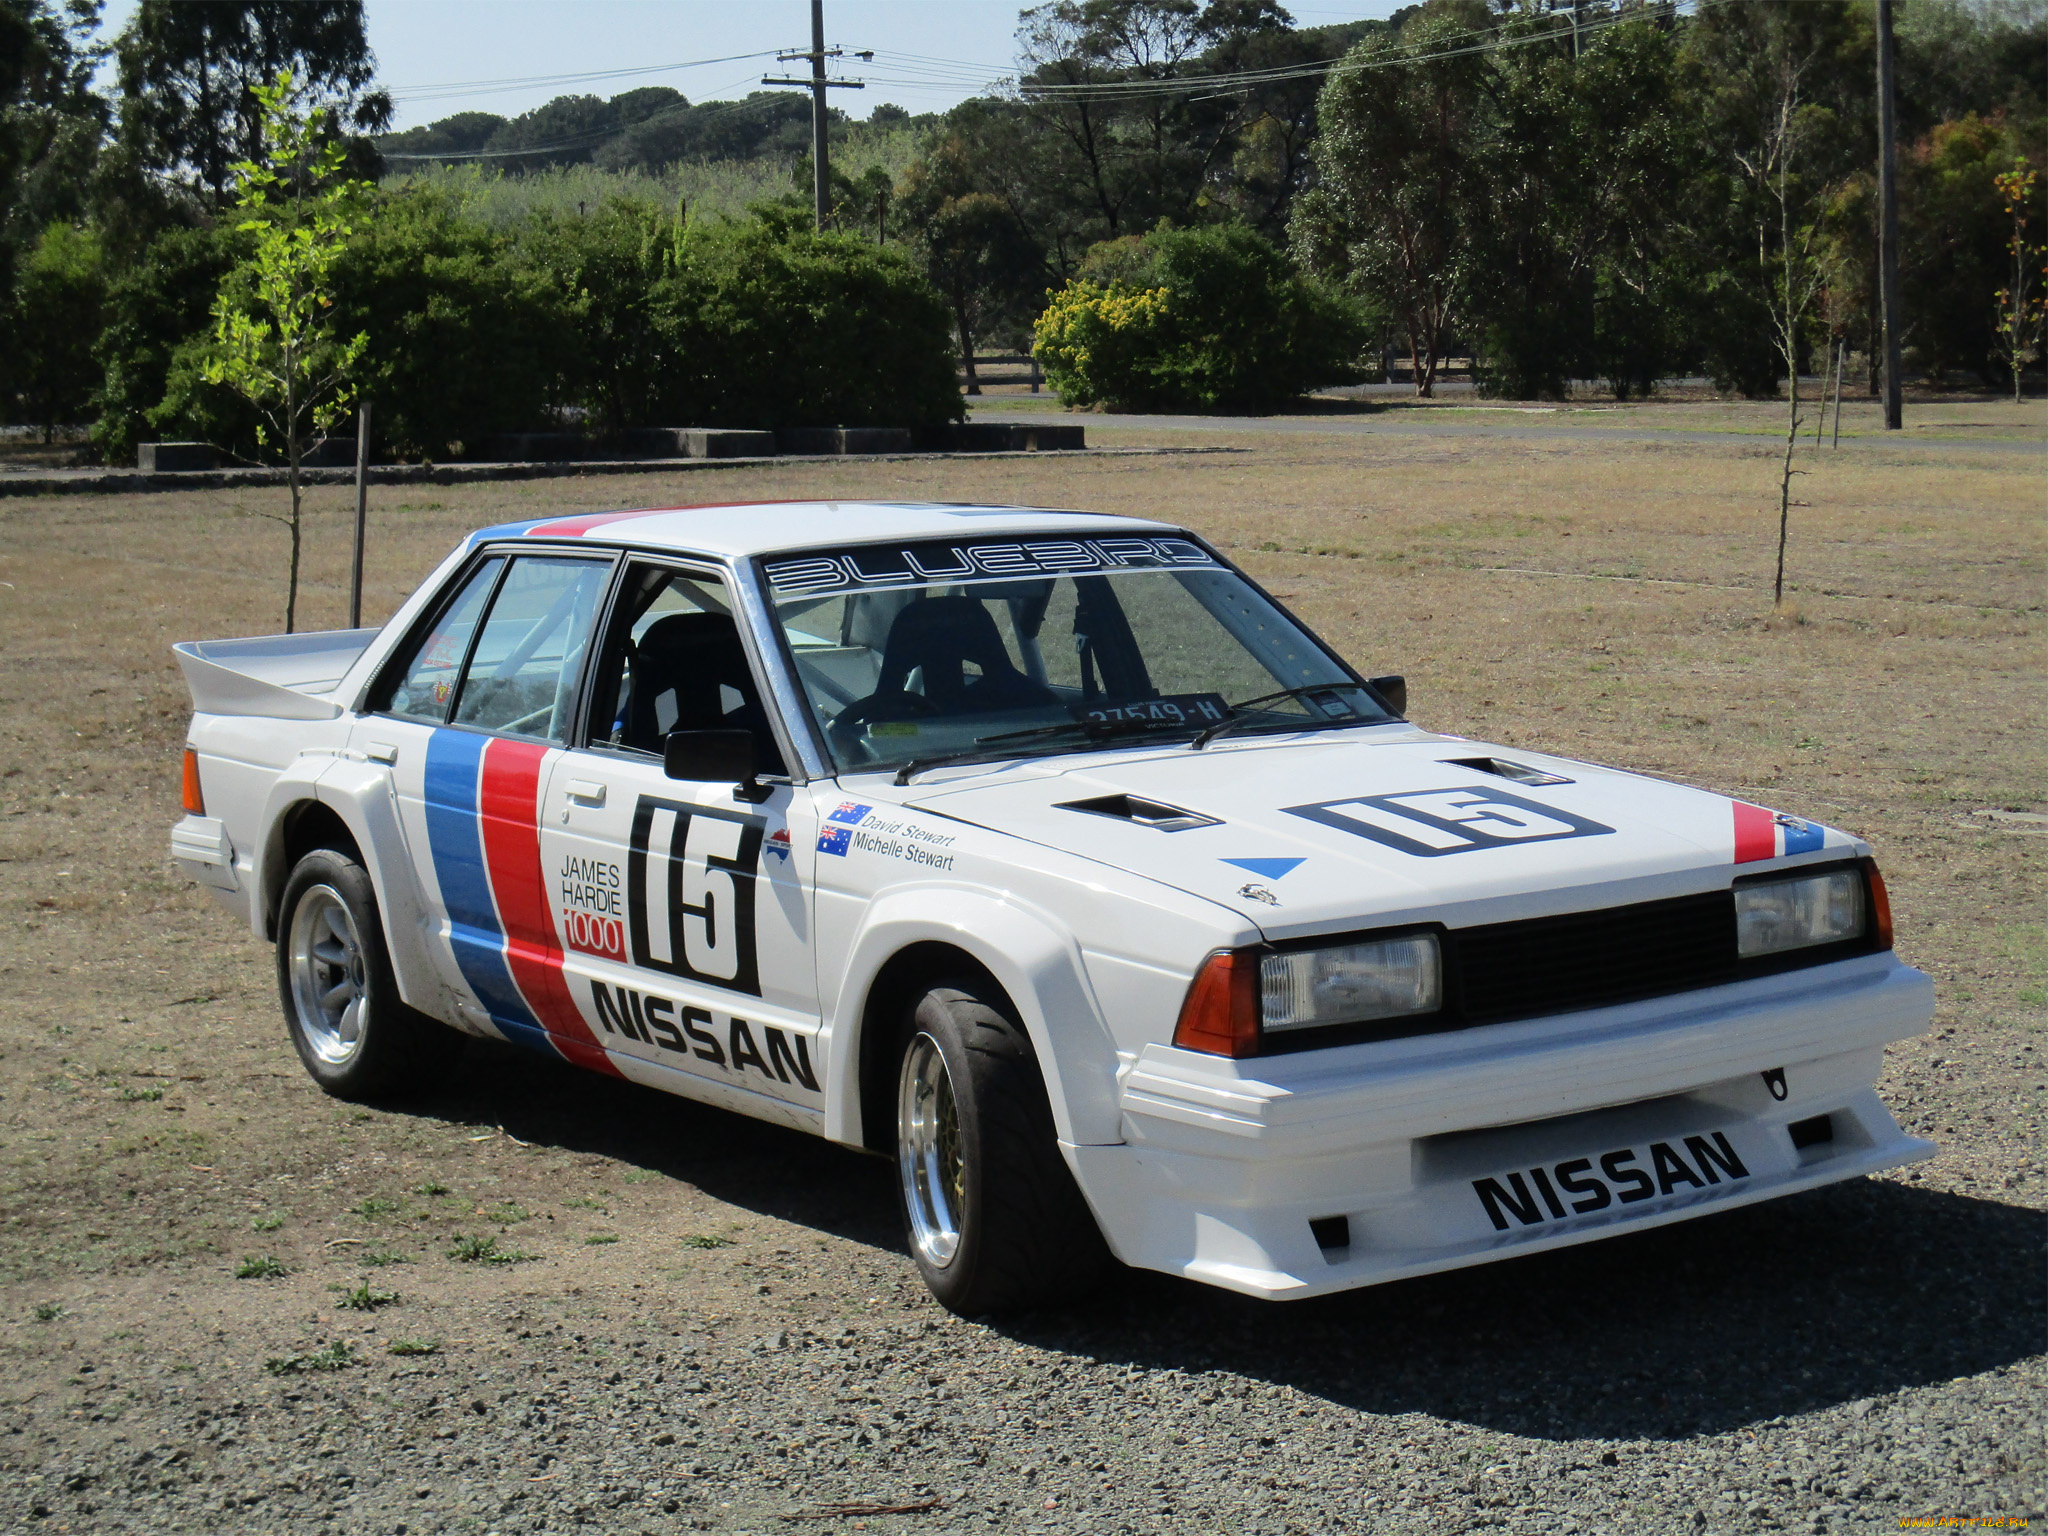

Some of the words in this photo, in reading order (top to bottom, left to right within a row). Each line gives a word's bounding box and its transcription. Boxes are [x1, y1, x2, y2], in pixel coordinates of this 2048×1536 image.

[765, 537, 1214, 594] BLUEBIRD
[861, 815, 904, 834] David
[901, 824, 957, 847] Stewart
[1321, 791, 1575, 849] 15
[561, 855, 620, 888] JAMES
[853, 831, 903, 858] Michelle
[905, 843, 954, 871] Stewart
[562, 881, 622, 916] HARDIE
[645, 806, 744, 981] 15
[564, 909, 620, 955] 1000
[590, 979, 822, 1093] NISSAN
[1472, 1131, 1751, 1231] NISSAN
